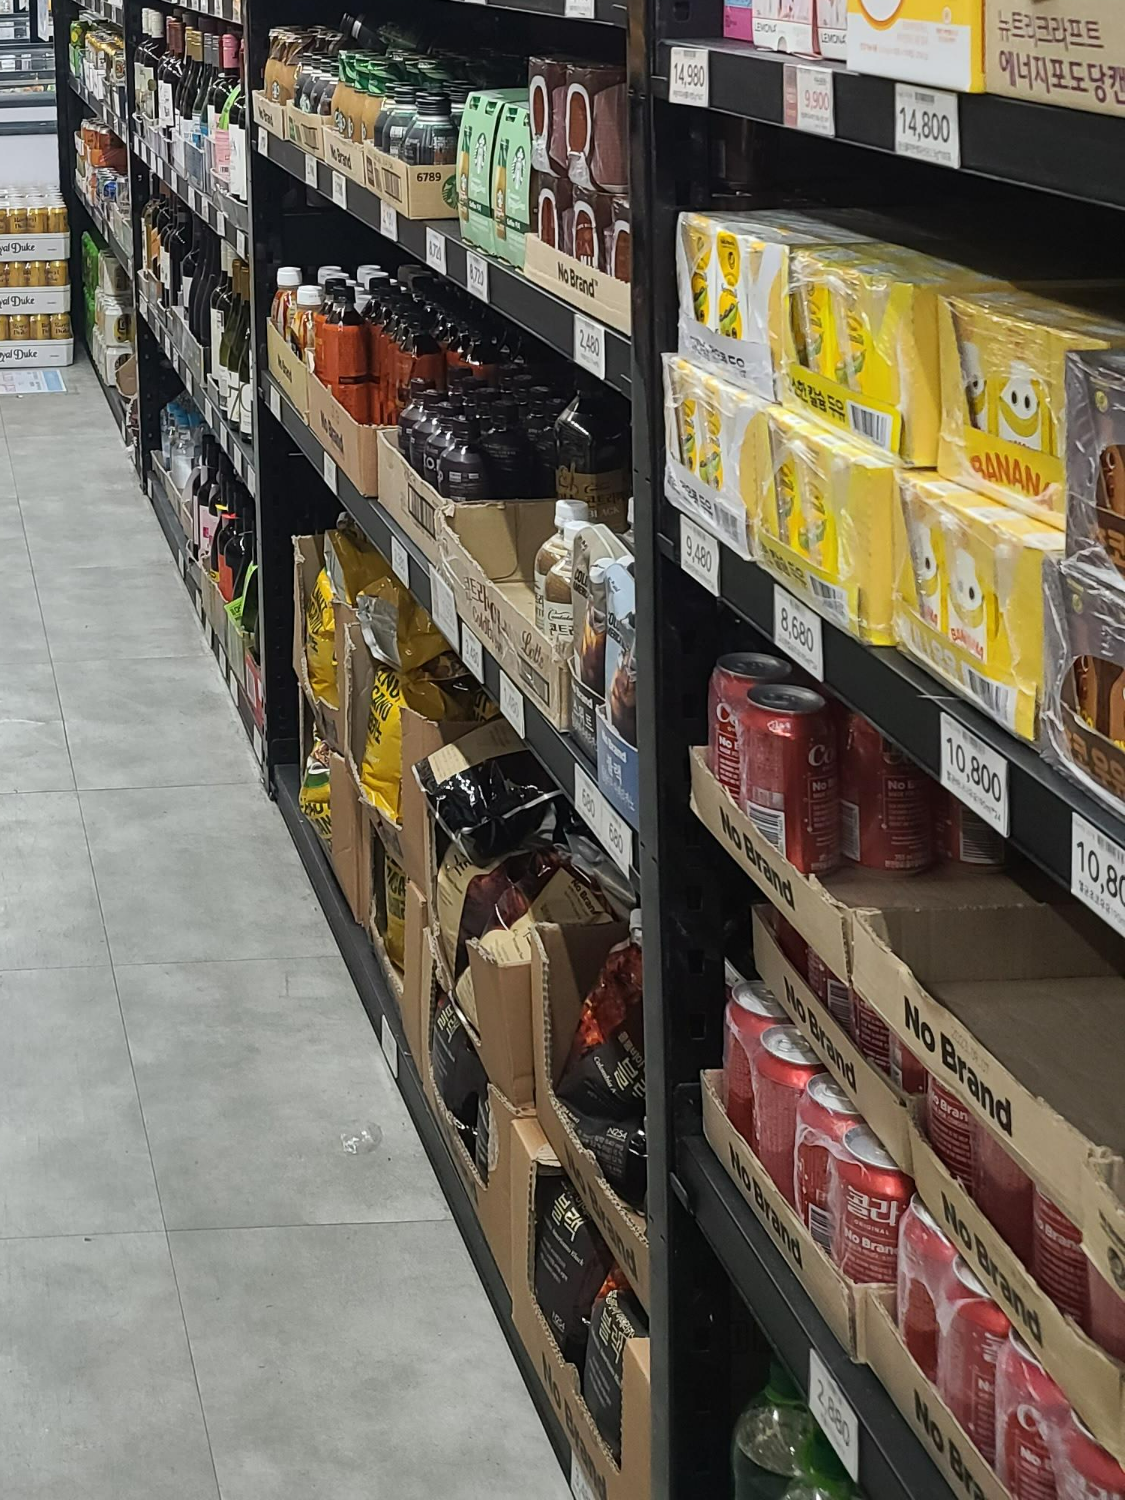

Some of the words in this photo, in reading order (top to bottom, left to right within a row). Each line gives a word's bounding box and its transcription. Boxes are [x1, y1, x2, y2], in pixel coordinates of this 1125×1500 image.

[754, 21, 777, 34] LEMONA
[997, 10, 1105, 52] 뉴트리크라프트
[673, 62, 706, 89] 14,980
[804, 88, 831, 112] 9,900
[898, 106, 951, 143] 14,800
[416, 171, 442, 183] 6789
[11, 242, 36, 254] Duke
[557, 261, 571, 283] No
[570, 266, 595, 298] Brand
[11, 295, 36, 307] Duke
[13, 348, 38, 360] Duke
[579, 330, 601, 357] 2,480
[685, 534, 713, 574] 9,480
[520, 630, 546, 670] Lotte
[779, 608, 816, 655] 8,680
[812, 781, 827, 792] No
[887, 780, 906, 790] No
[945, 735, 1003, 804] 10,800
[580, 788, 597, 819] 680
[607, 823, 625, 855] 680
[720, 806, 743, 851] No
[742, 833, 796, 912] Brand
[570, 879, 582, 894] No
[579, 888, 601, 916] Brand
[783, 975, 807, 1024] No
[806, 1005, 858, 1094] Brand
[904, 995, 936, 1054] No
[940, 1032, 1013, 1138] Brand
[606, 1126, 628, 1140] N254
[550, 1192, 585, 1242] 블랙
[728, 1143, 761, 1199] No
[757, 1190, 803, 1271] Brand
[846, 1185, 899, 1228] 콜라
[844, 1226, 861, 1245] No
[853, 1219, 891, 1236] ORIGINAL
[941, 1190, 973, 1251] No
[974, 1244, 1043, 1349] Brand
[914, 1388, 945, 1455] No
